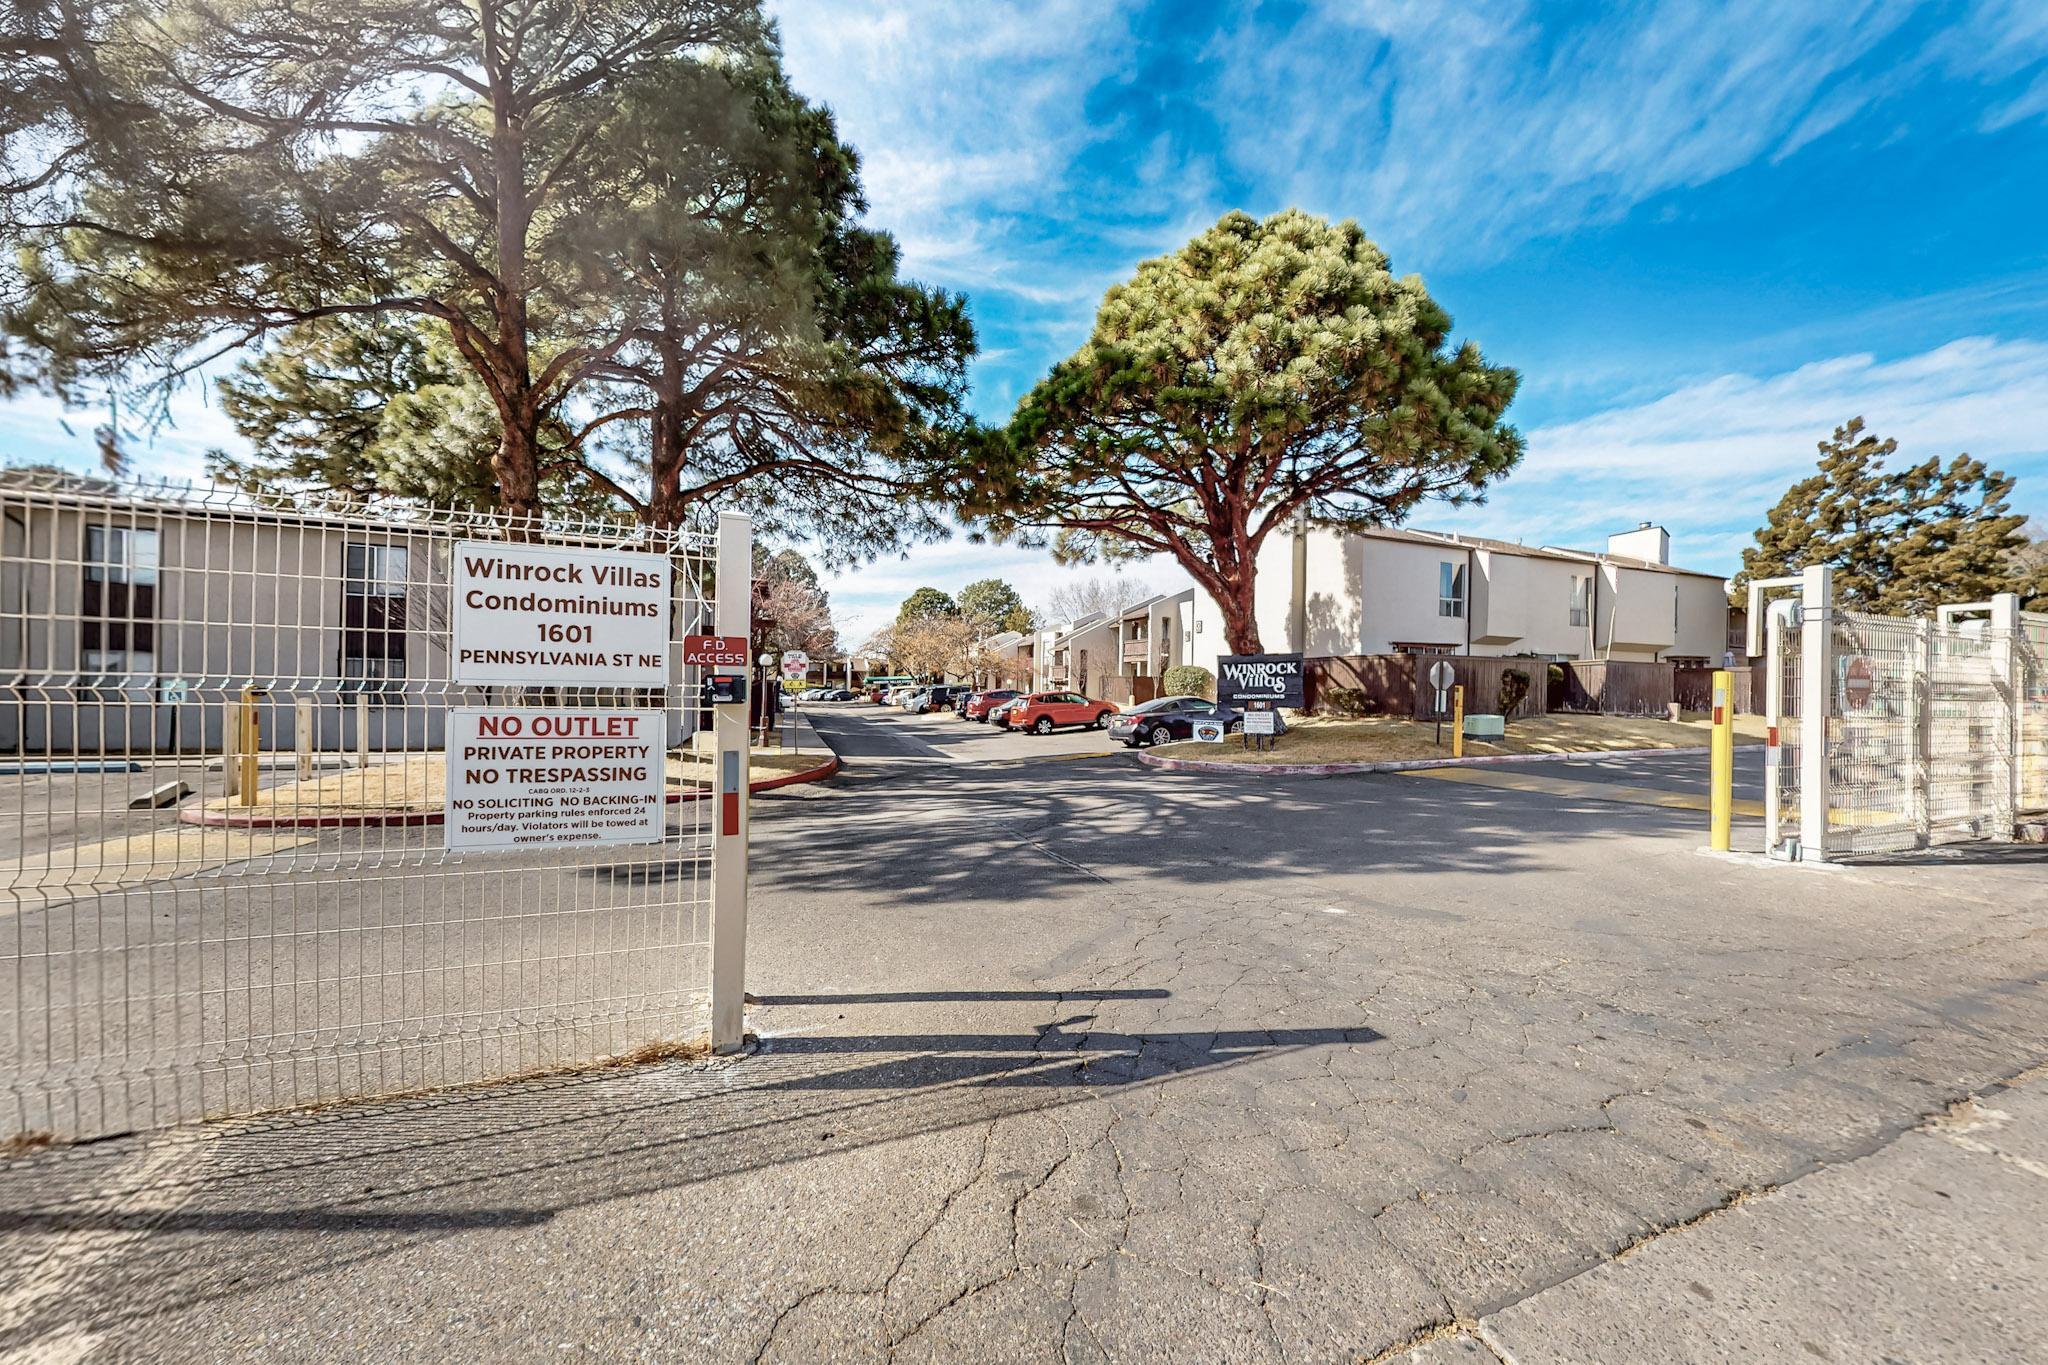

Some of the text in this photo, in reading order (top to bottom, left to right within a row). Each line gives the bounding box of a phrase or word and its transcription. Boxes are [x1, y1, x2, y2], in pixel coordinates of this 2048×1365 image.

[464, 557, 661, 588] Winrock Villas
[466, 590, 658, 617] Condominiums
[537, 623, 592, 643] 1601
[703, 640, 728, 650] F.D.
[460, 650, 662, 668] PENNSYLVANIA ST NE
[686, 653, 745, 663] ACCESS
[1222, 662, 1298, 681] WINROCK
[479, 716, 639, 736] NO OUTLET
[464, 746, 650, 760] PRIVATE PROPERTY
[466, 767, 647, 784] NO TRESPASSING
[453, 795, 656, 809] NO SOLICITING NO BACKING-IN
[468, 807, 646, 821] Property parking rules enforced 24
[461, 823, 518, 833] hours/day.
[522, 822, 568, 830] Violators
[571, 820, 588, 828] will
[591, 820, 603, 828] be
[606, 819, 636, 827] towed
[557, 833, 601, 841] expense.
